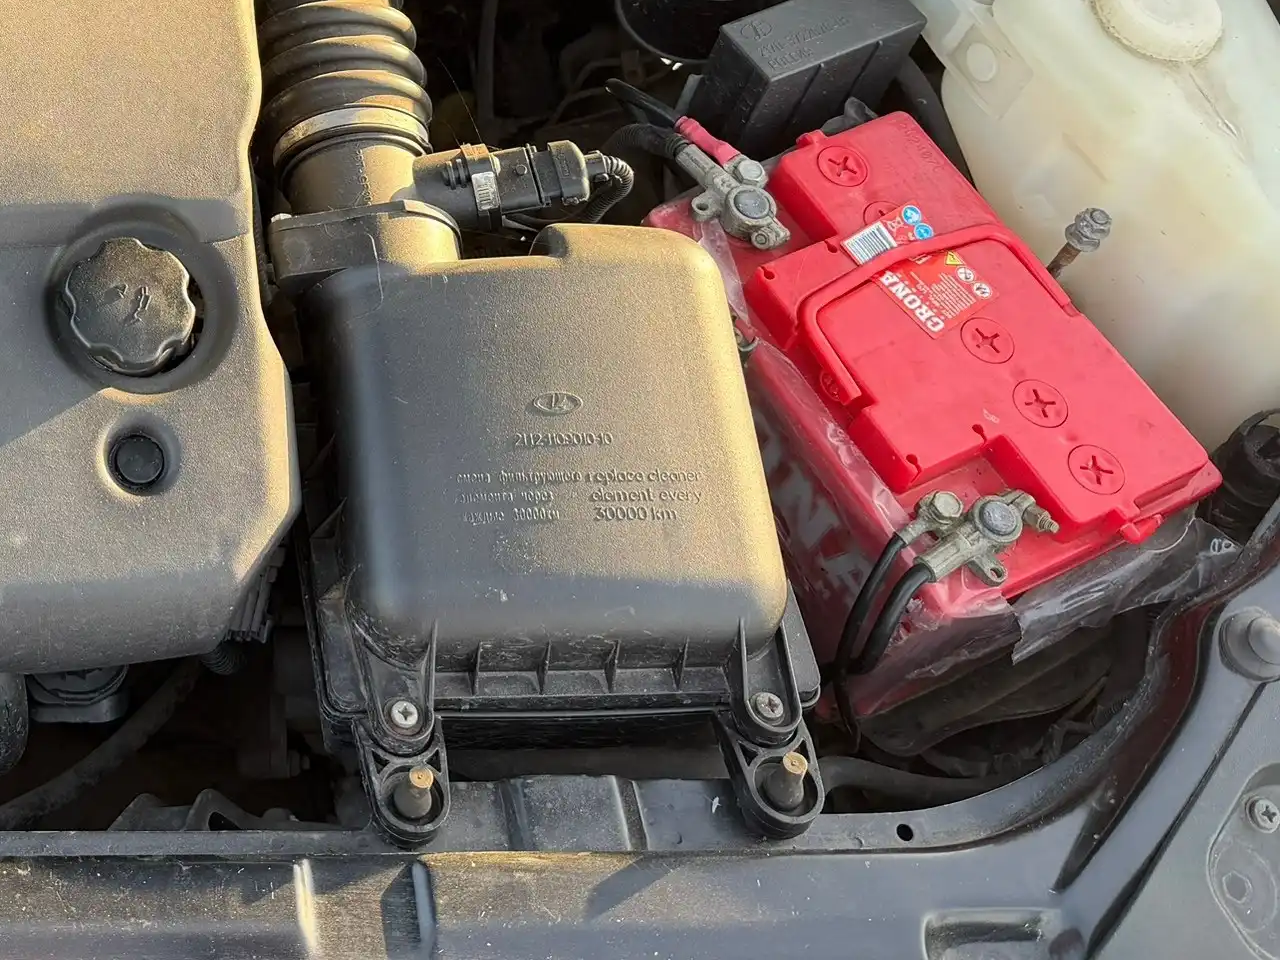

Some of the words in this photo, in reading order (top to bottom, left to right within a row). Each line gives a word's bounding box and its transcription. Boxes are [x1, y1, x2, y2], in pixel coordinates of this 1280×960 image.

[879, 270, 946, 333] CRONA
[587, 470, 644, 488] replace
[646, 468, 702, 483] cleaner
[591, 488, 655, 503] element
[658, 490, 702, 505] every
[594, 506, 648, 522] 30000
[650, 506, 678, 522] km
